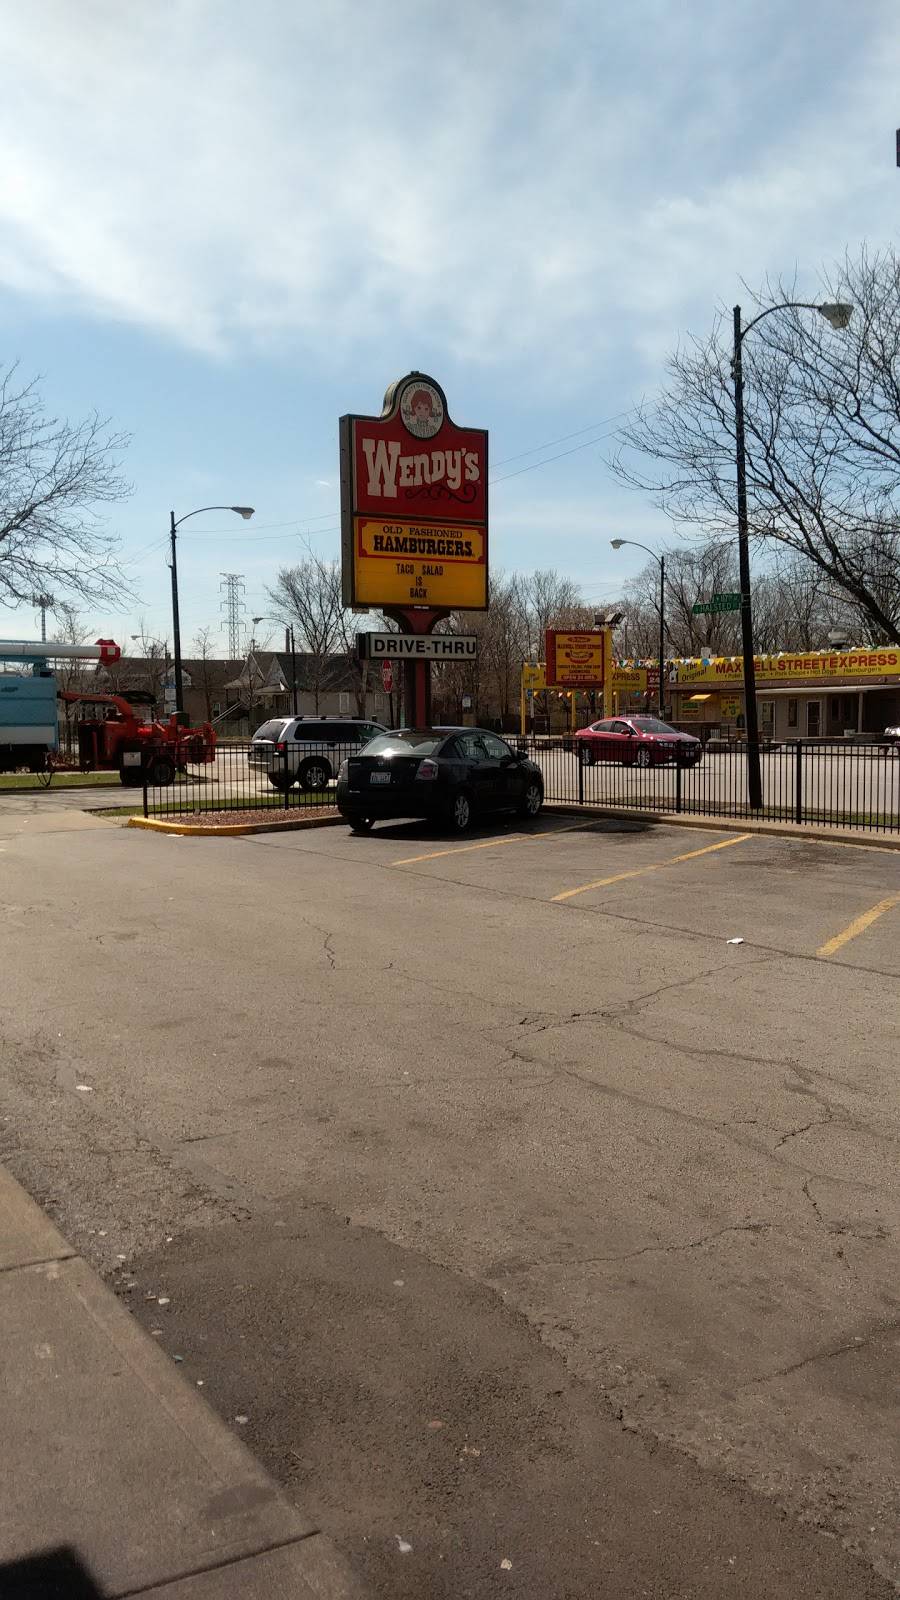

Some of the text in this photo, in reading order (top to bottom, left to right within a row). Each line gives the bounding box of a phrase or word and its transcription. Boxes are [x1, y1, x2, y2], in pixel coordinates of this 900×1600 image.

[382, 525, 463, 538] OLD FASHIONED
[373, 535, 473, 557] HAMBURGERS
[396, 563, 444, 576] TACO SALAD
[415, 576, 423, 587] IS
[410, 587, 427, 599] BACK
[374, 638, 476, 654] DRIVE-THRU
[715, 653, 898, 674] MAXELL STREET EXPRESS
[612, 672, 641, 681] XPRESS
[681, 667, 707, 682] Original
